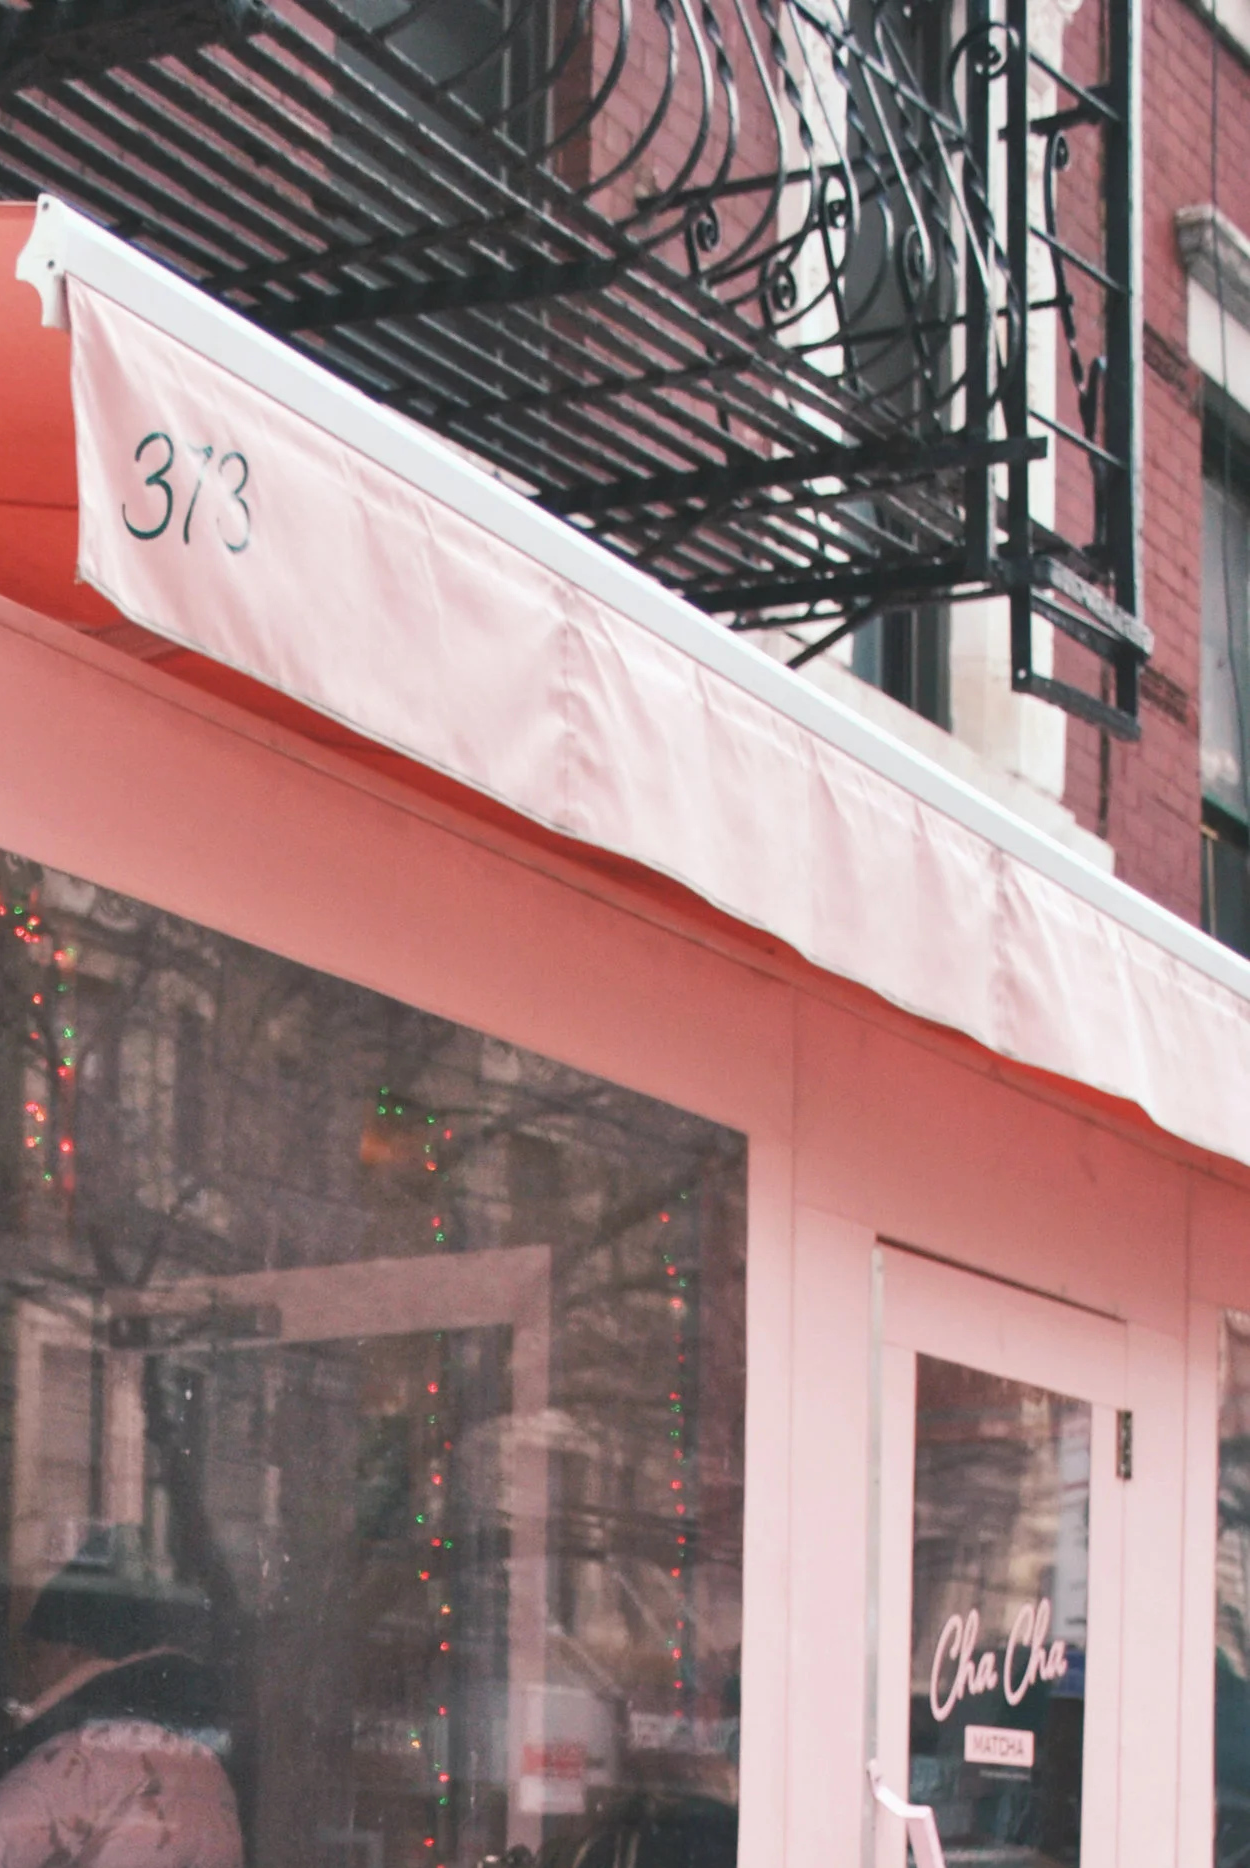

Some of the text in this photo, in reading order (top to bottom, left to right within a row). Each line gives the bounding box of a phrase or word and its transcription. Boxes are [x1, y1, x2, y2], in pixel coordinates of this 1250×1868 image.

[122, 431, 250, 554] 373
[930, 1597, 1068, 1722] Cha Cha
[973, 1735, 1024, 1758] MATCHA
